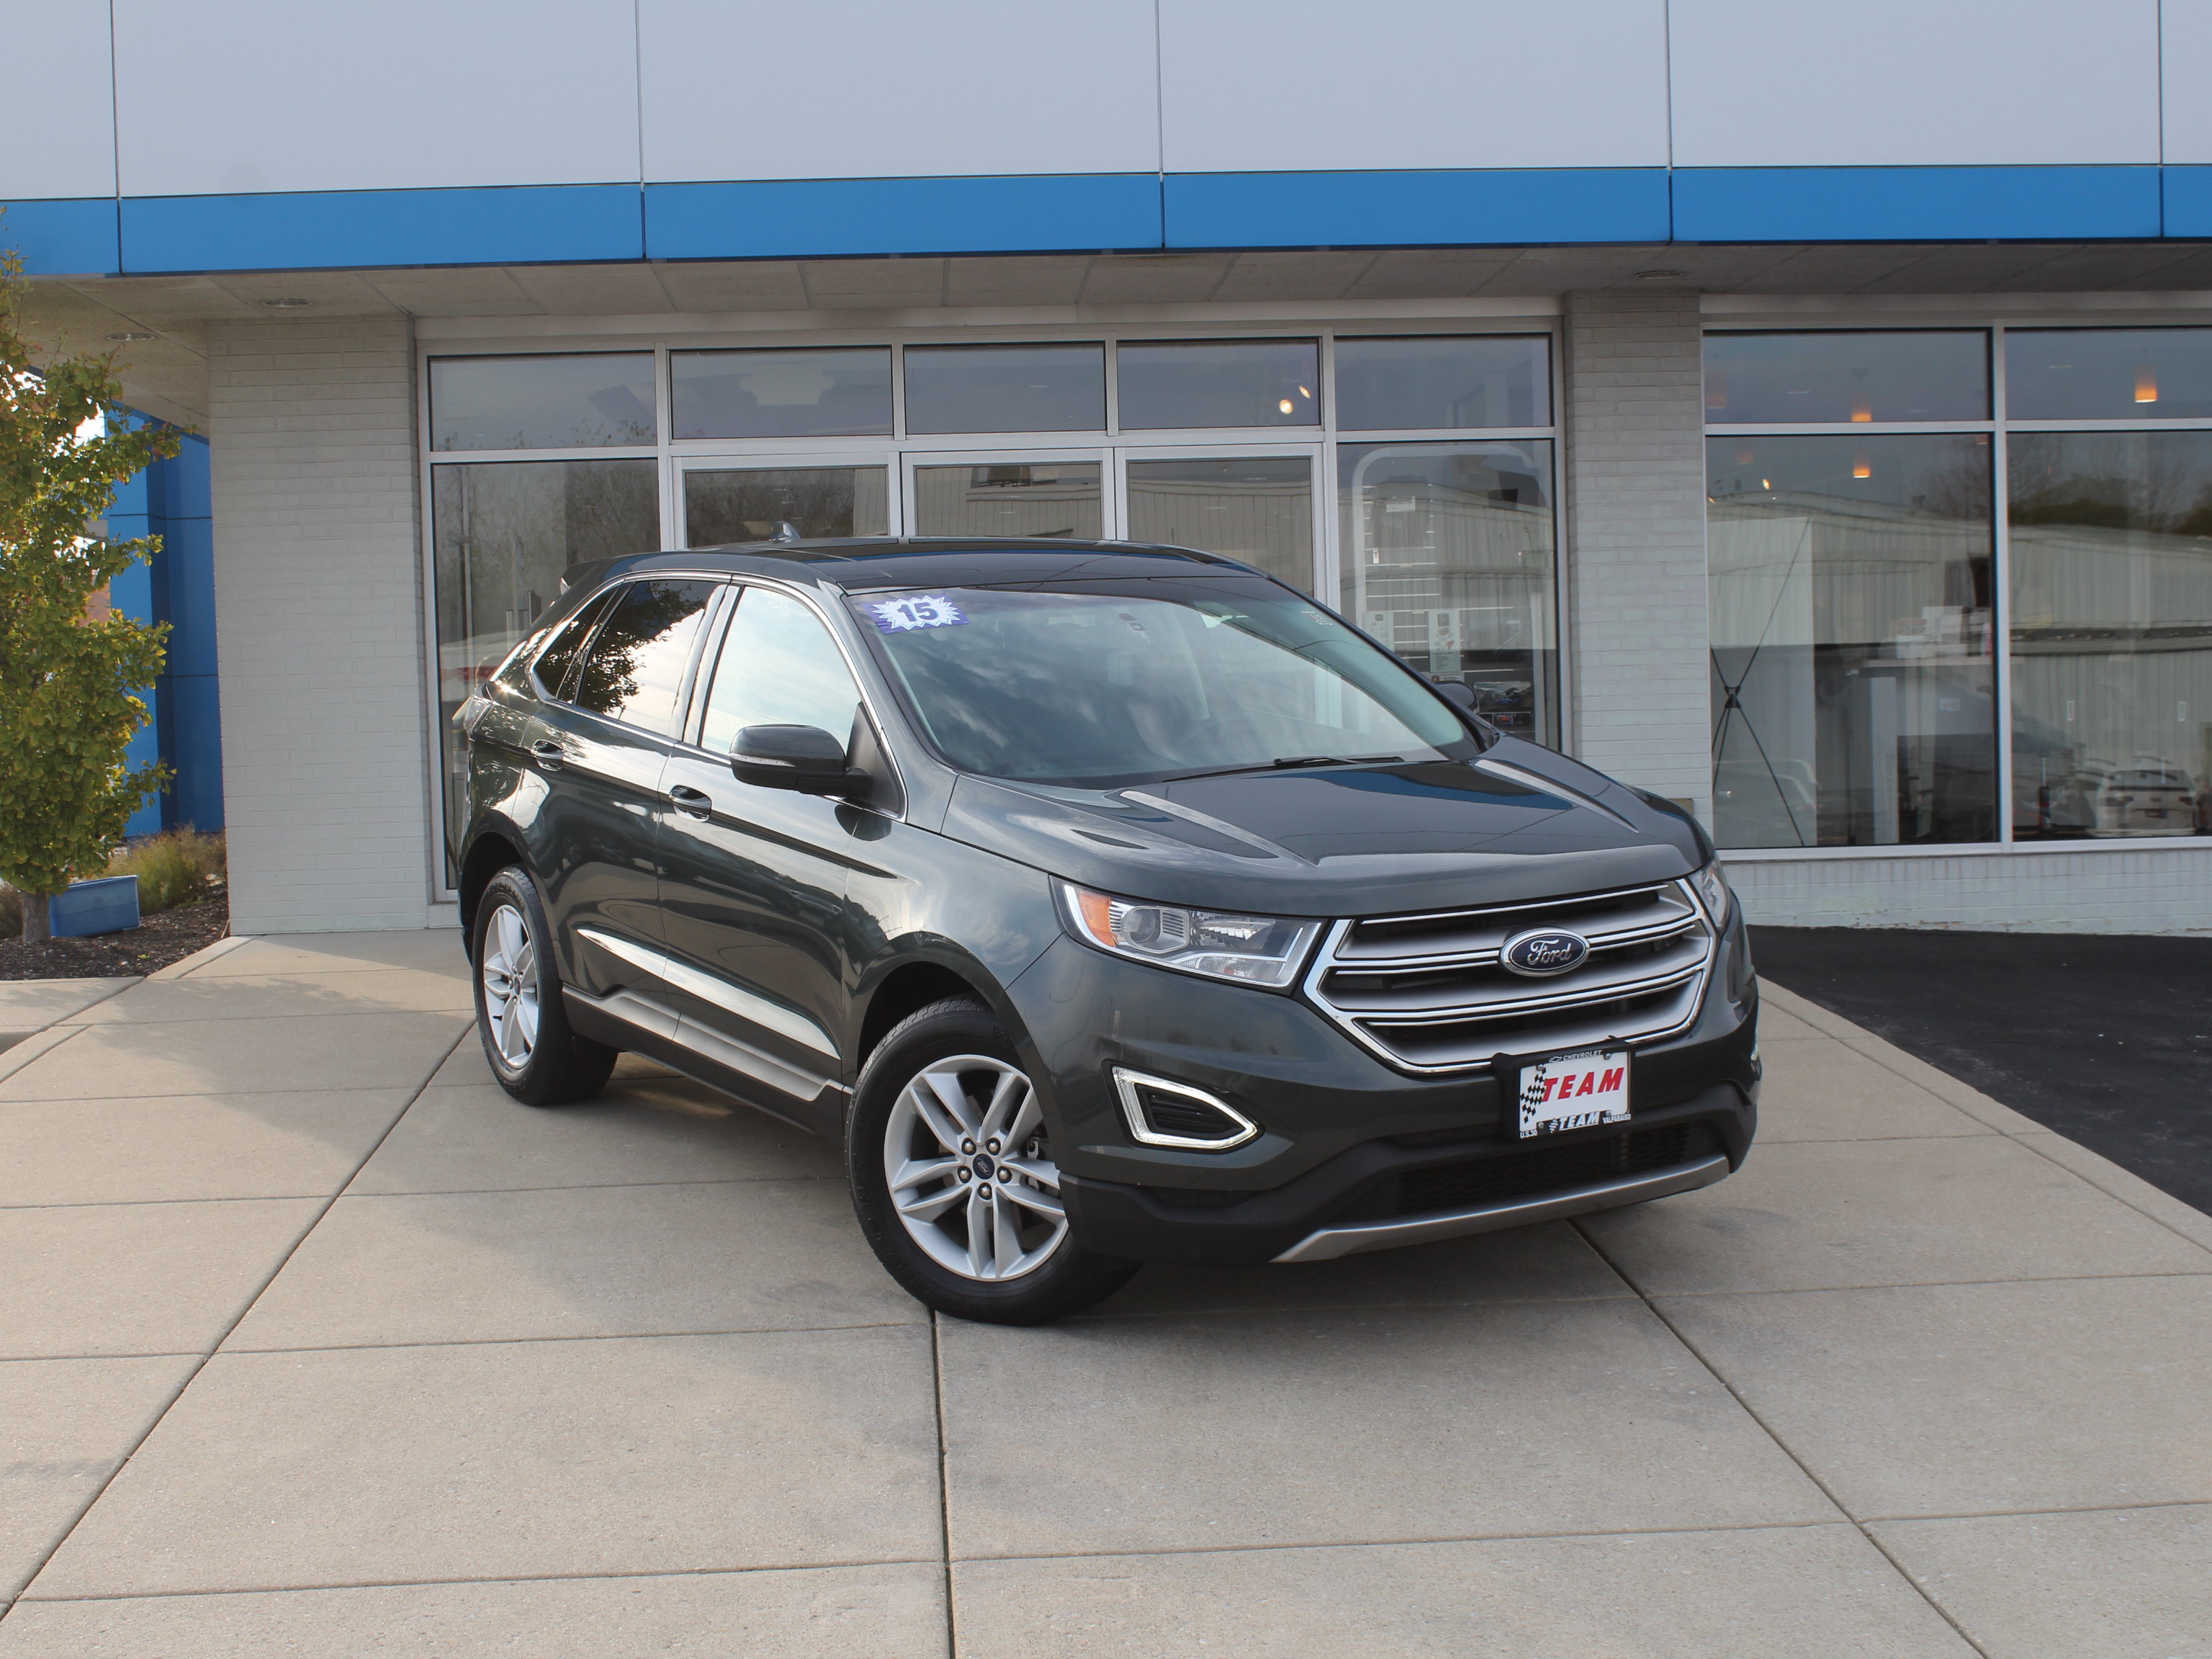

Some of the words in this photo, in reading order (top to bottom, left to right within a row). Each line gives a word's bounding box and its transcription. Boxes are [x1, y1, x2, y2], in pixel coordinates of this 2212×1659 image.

[897, 602, 939, 622] 15
[1527, 939, 1572, 966] Ford
[1563, 1050, 1603, 1061] CHEVROLET
[1542, 1067, 1624, 1102] TEAM
[1560, 1111, 1601, 1130] TEAM
[1603, 1114, 1631, 1124] VALPARAISO
